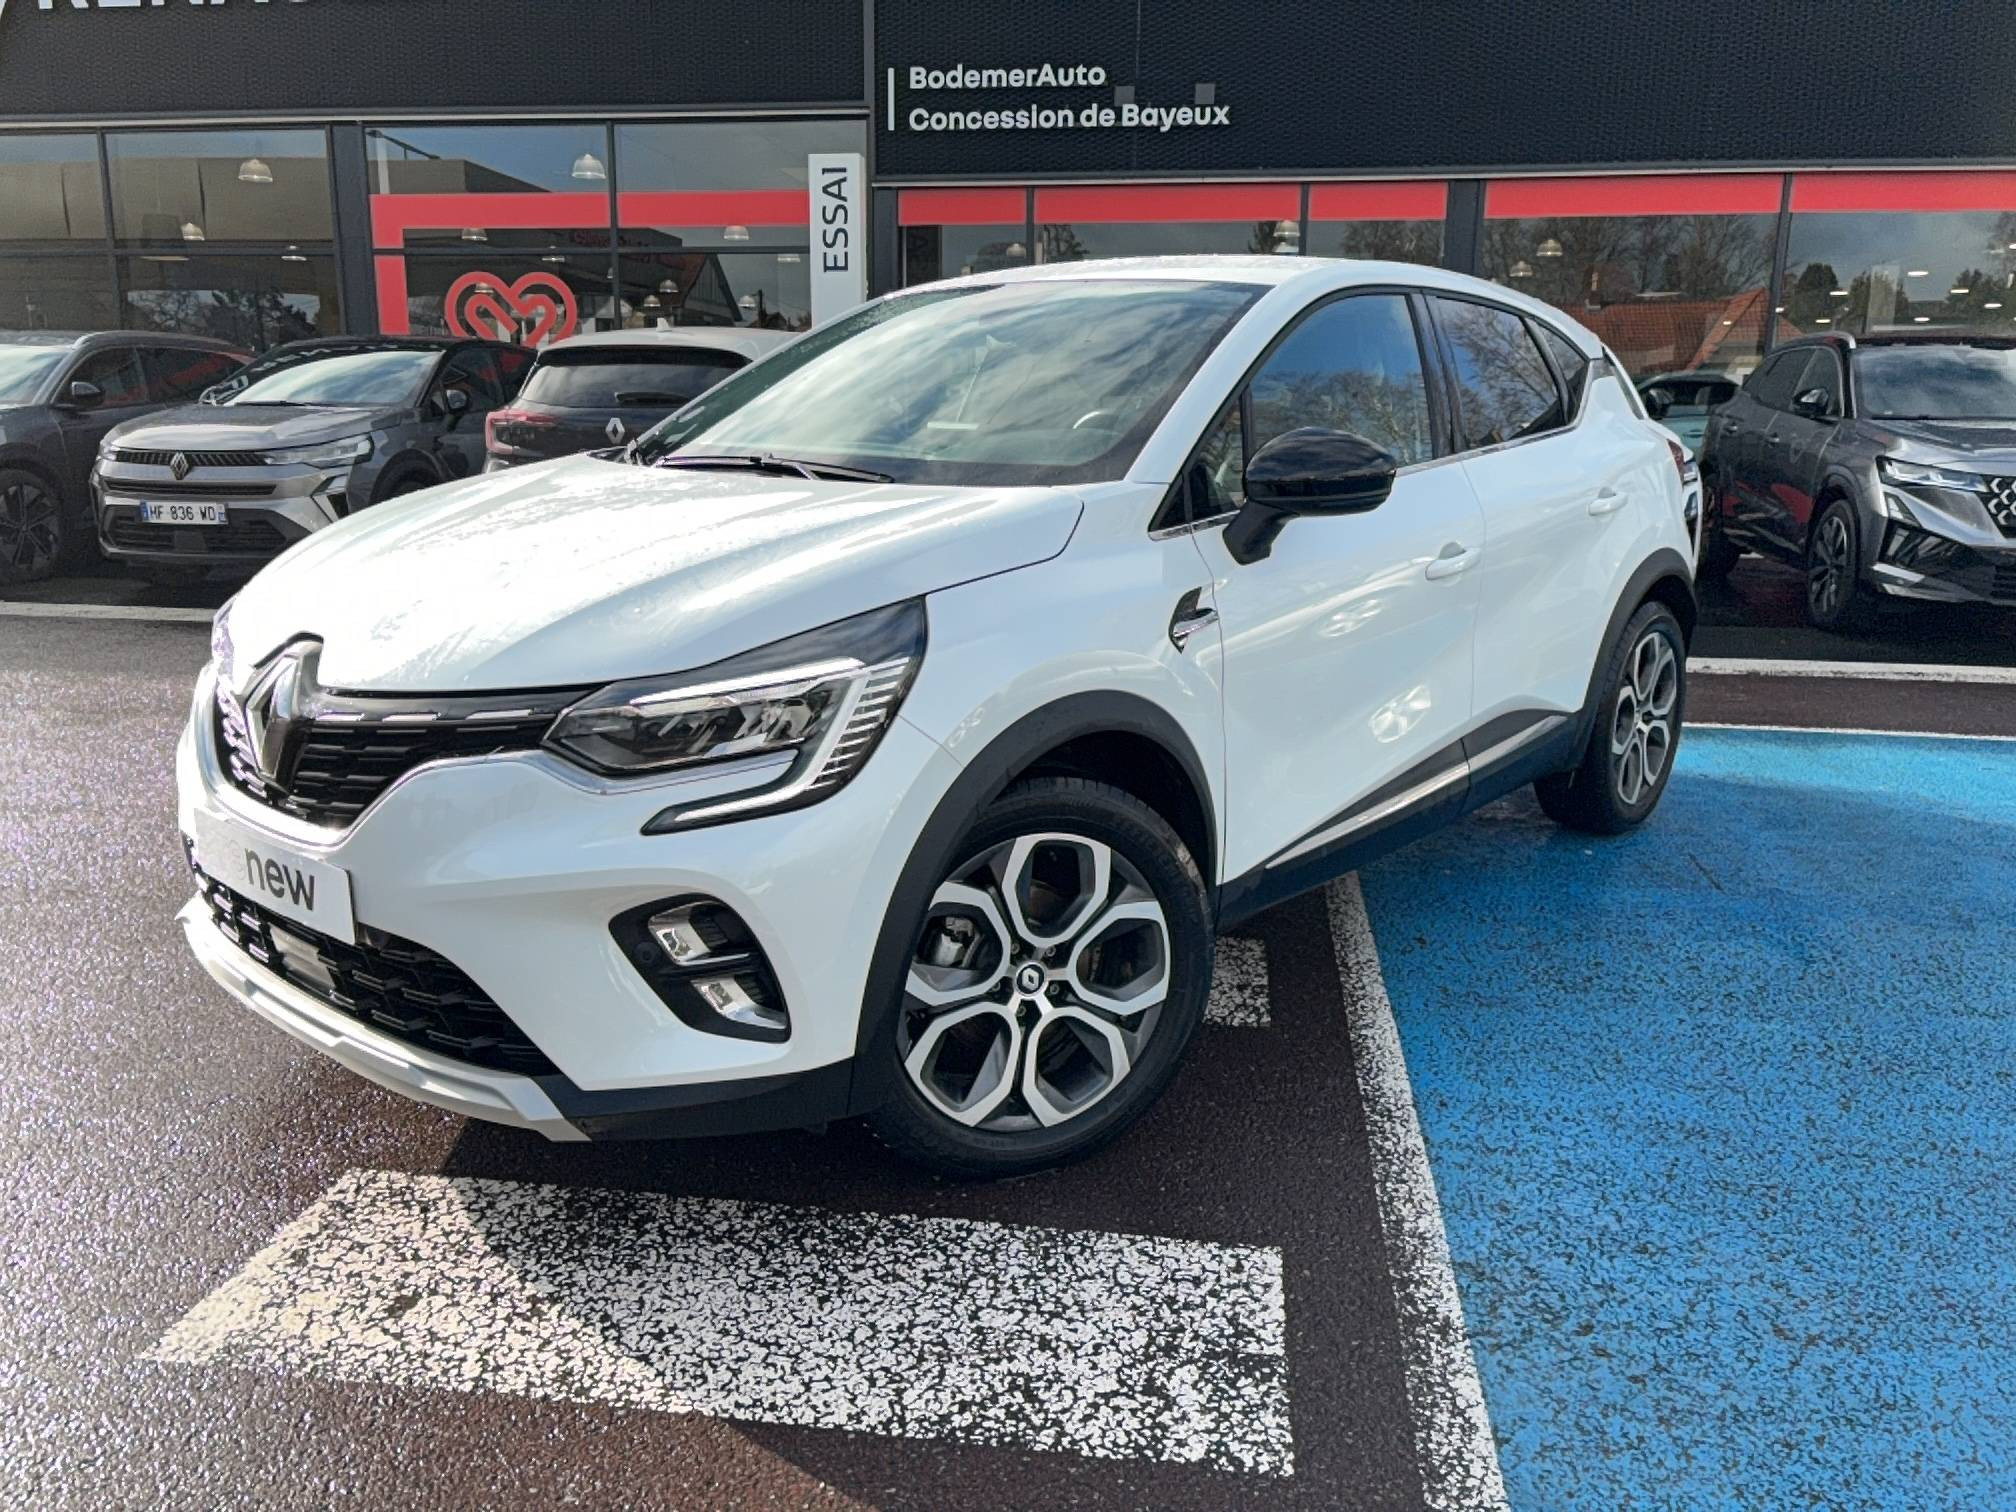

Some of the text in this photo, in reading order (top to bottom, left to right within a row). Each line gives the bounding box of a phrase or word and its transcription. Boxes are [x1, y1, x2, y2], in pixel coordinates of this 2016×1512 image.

[909, 63, 1106, 90] BodemerAuto
[908, 103, 1231, 132] Concession de Bayeux
[822, 166, 849, 273] ESSAI
[148, 504, 164, 520] HF
[169, 505, 194, 521] 836
